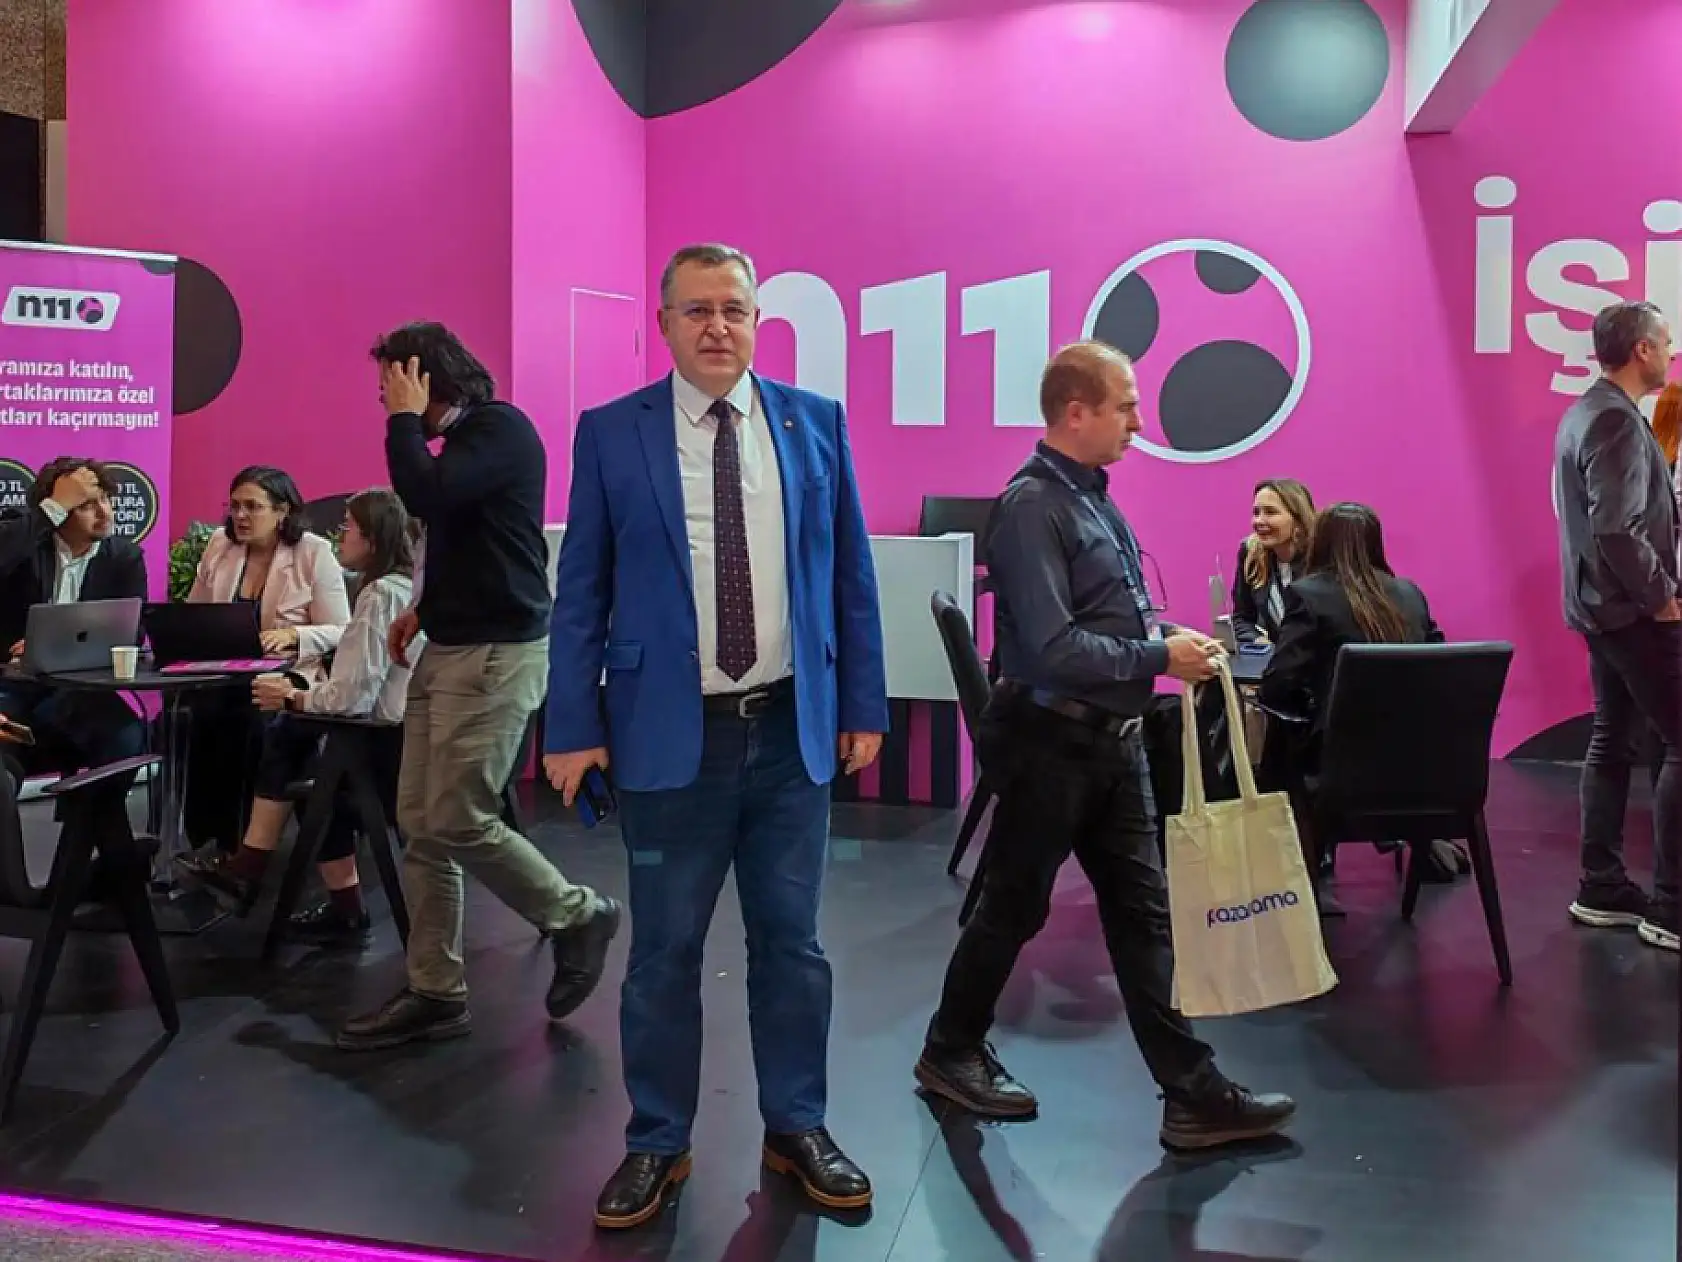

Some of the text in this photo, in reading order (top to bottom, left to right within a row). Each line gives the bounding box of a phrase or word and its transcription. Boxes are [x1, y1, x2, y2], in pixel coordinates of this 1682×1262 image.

[17, 294, 72, 321] n11
[118, 386, 154, 404] özel
[48, 407, 159, 431] kaçırmayın!
[0, 494, 27, 507] AM
